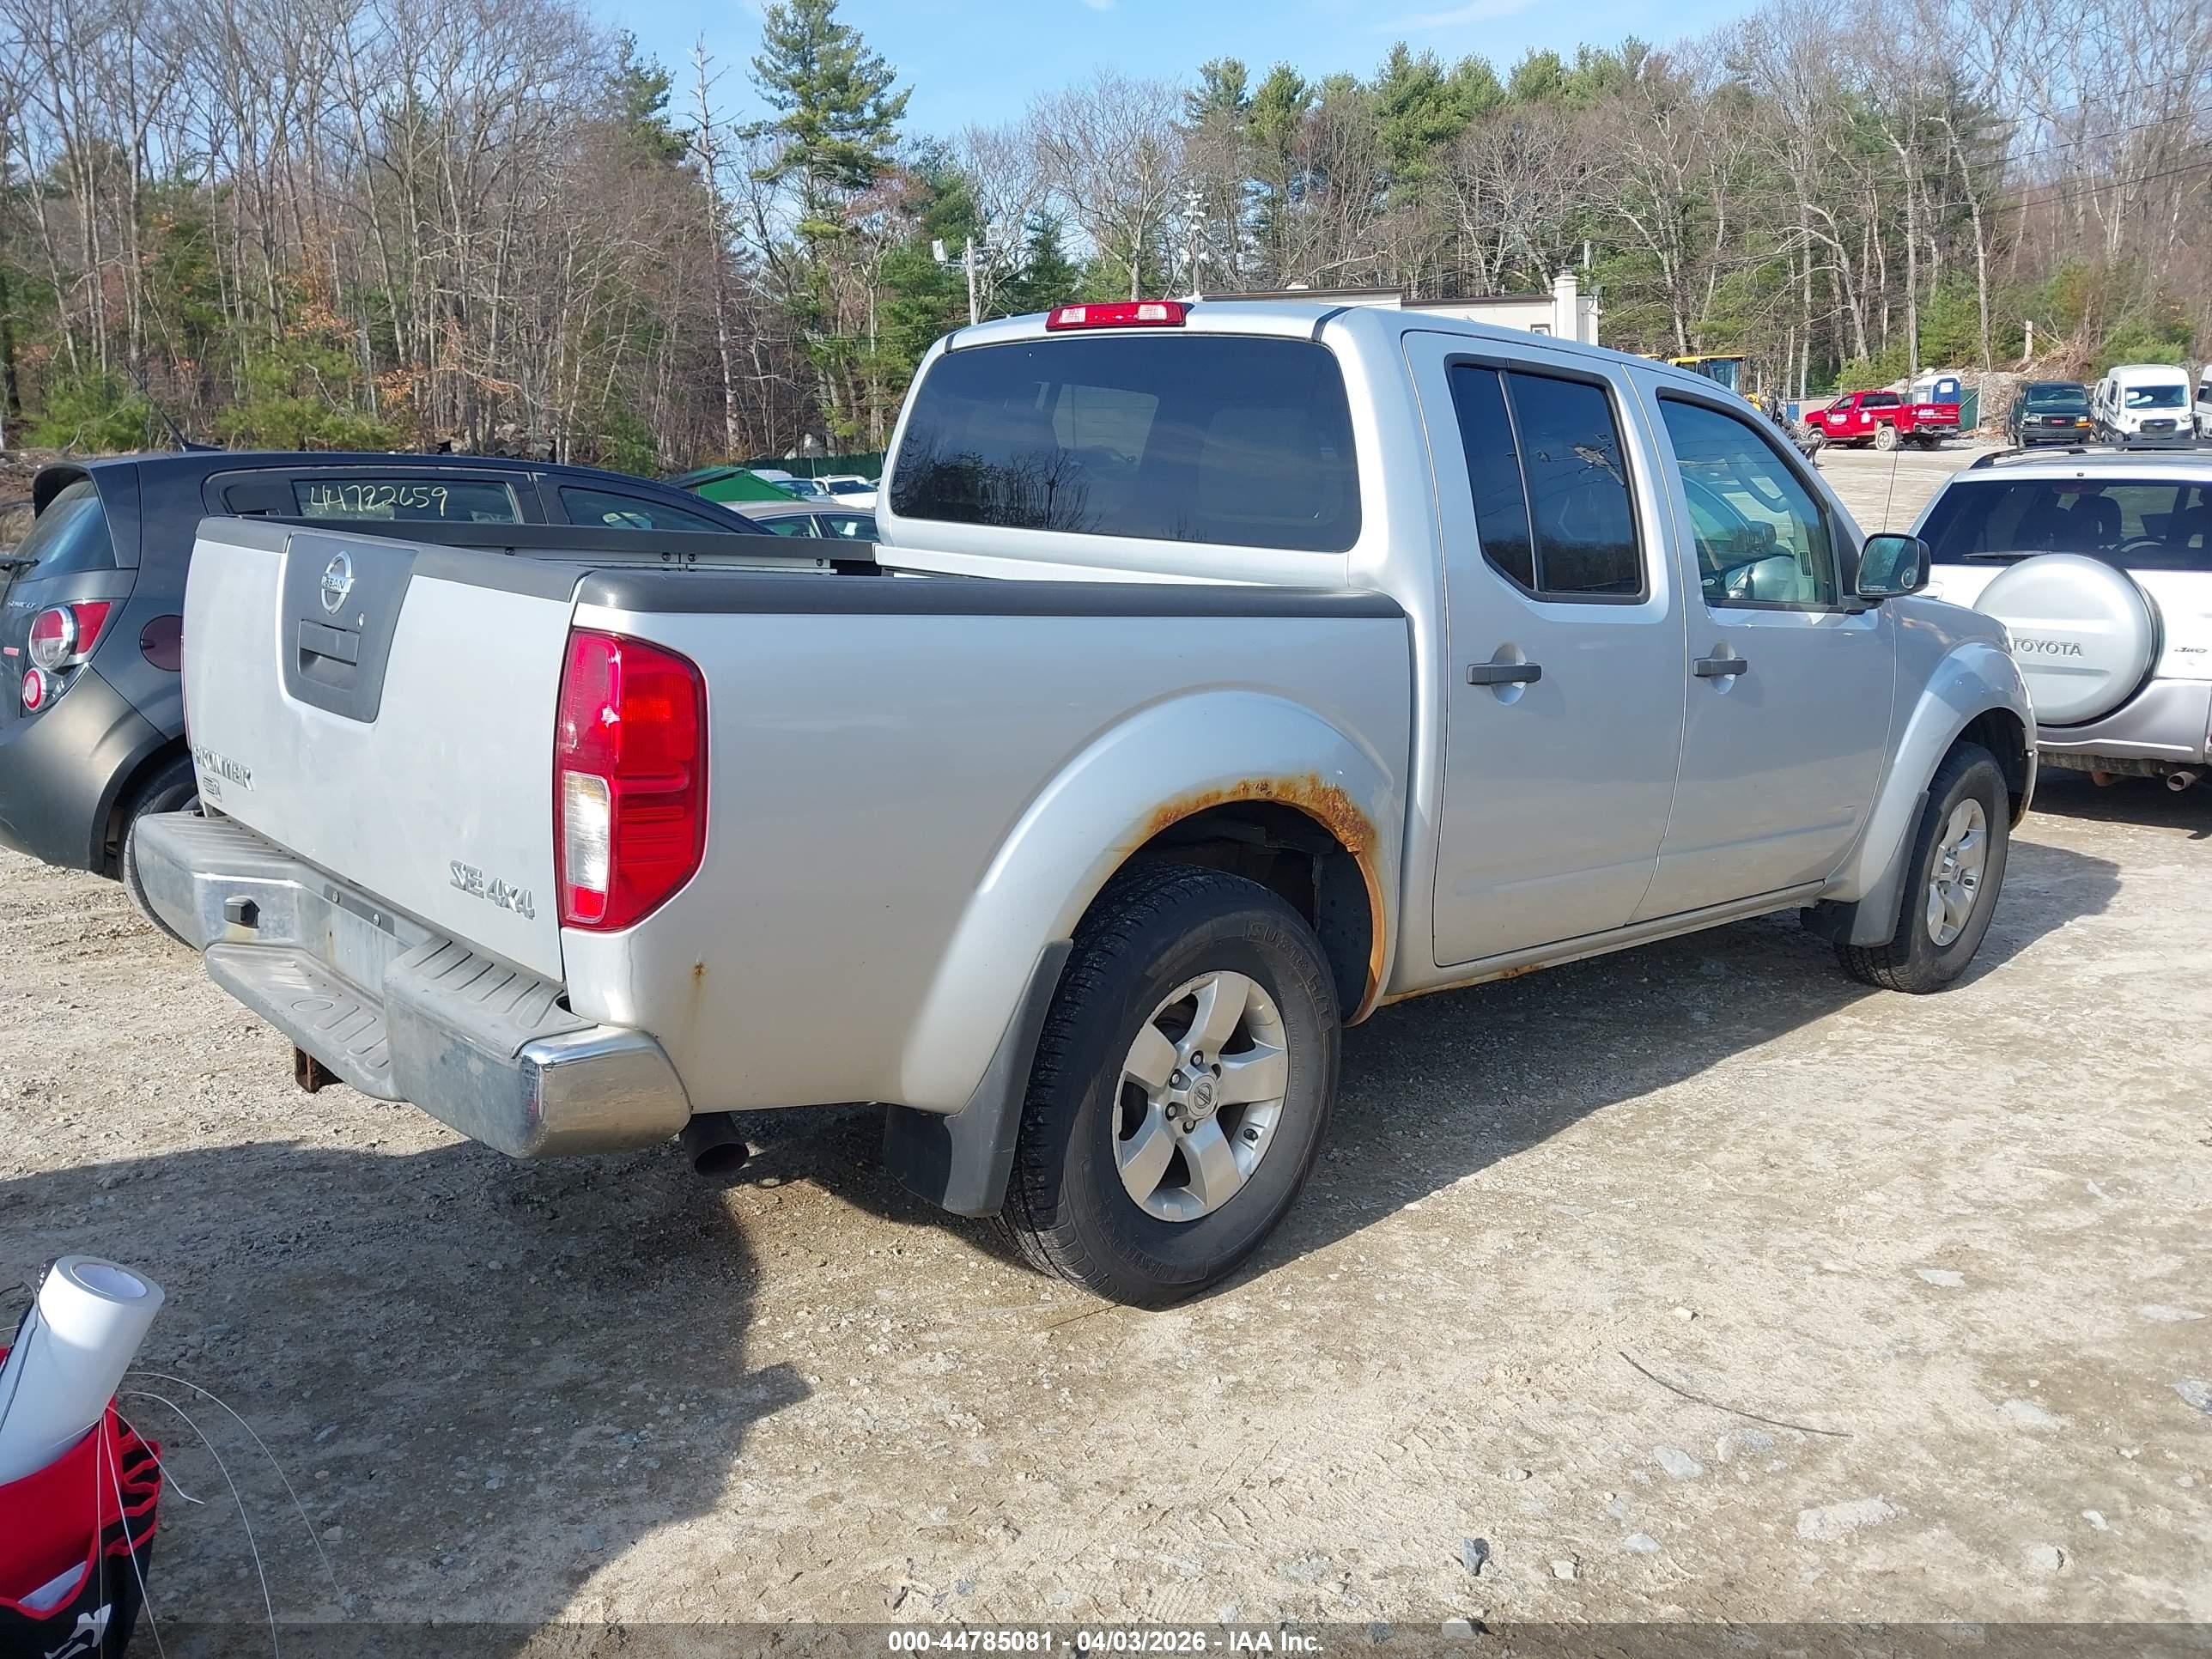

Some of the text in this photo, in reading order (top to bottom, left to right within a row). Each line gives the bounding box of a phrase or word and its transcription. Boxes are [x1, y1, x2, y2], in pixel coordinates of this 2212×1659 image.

[2012, 637, 2083, 657] TOYOTA
[193, 745, 254, 792] FRONTIER
[449, 860, 484, 899] SE
